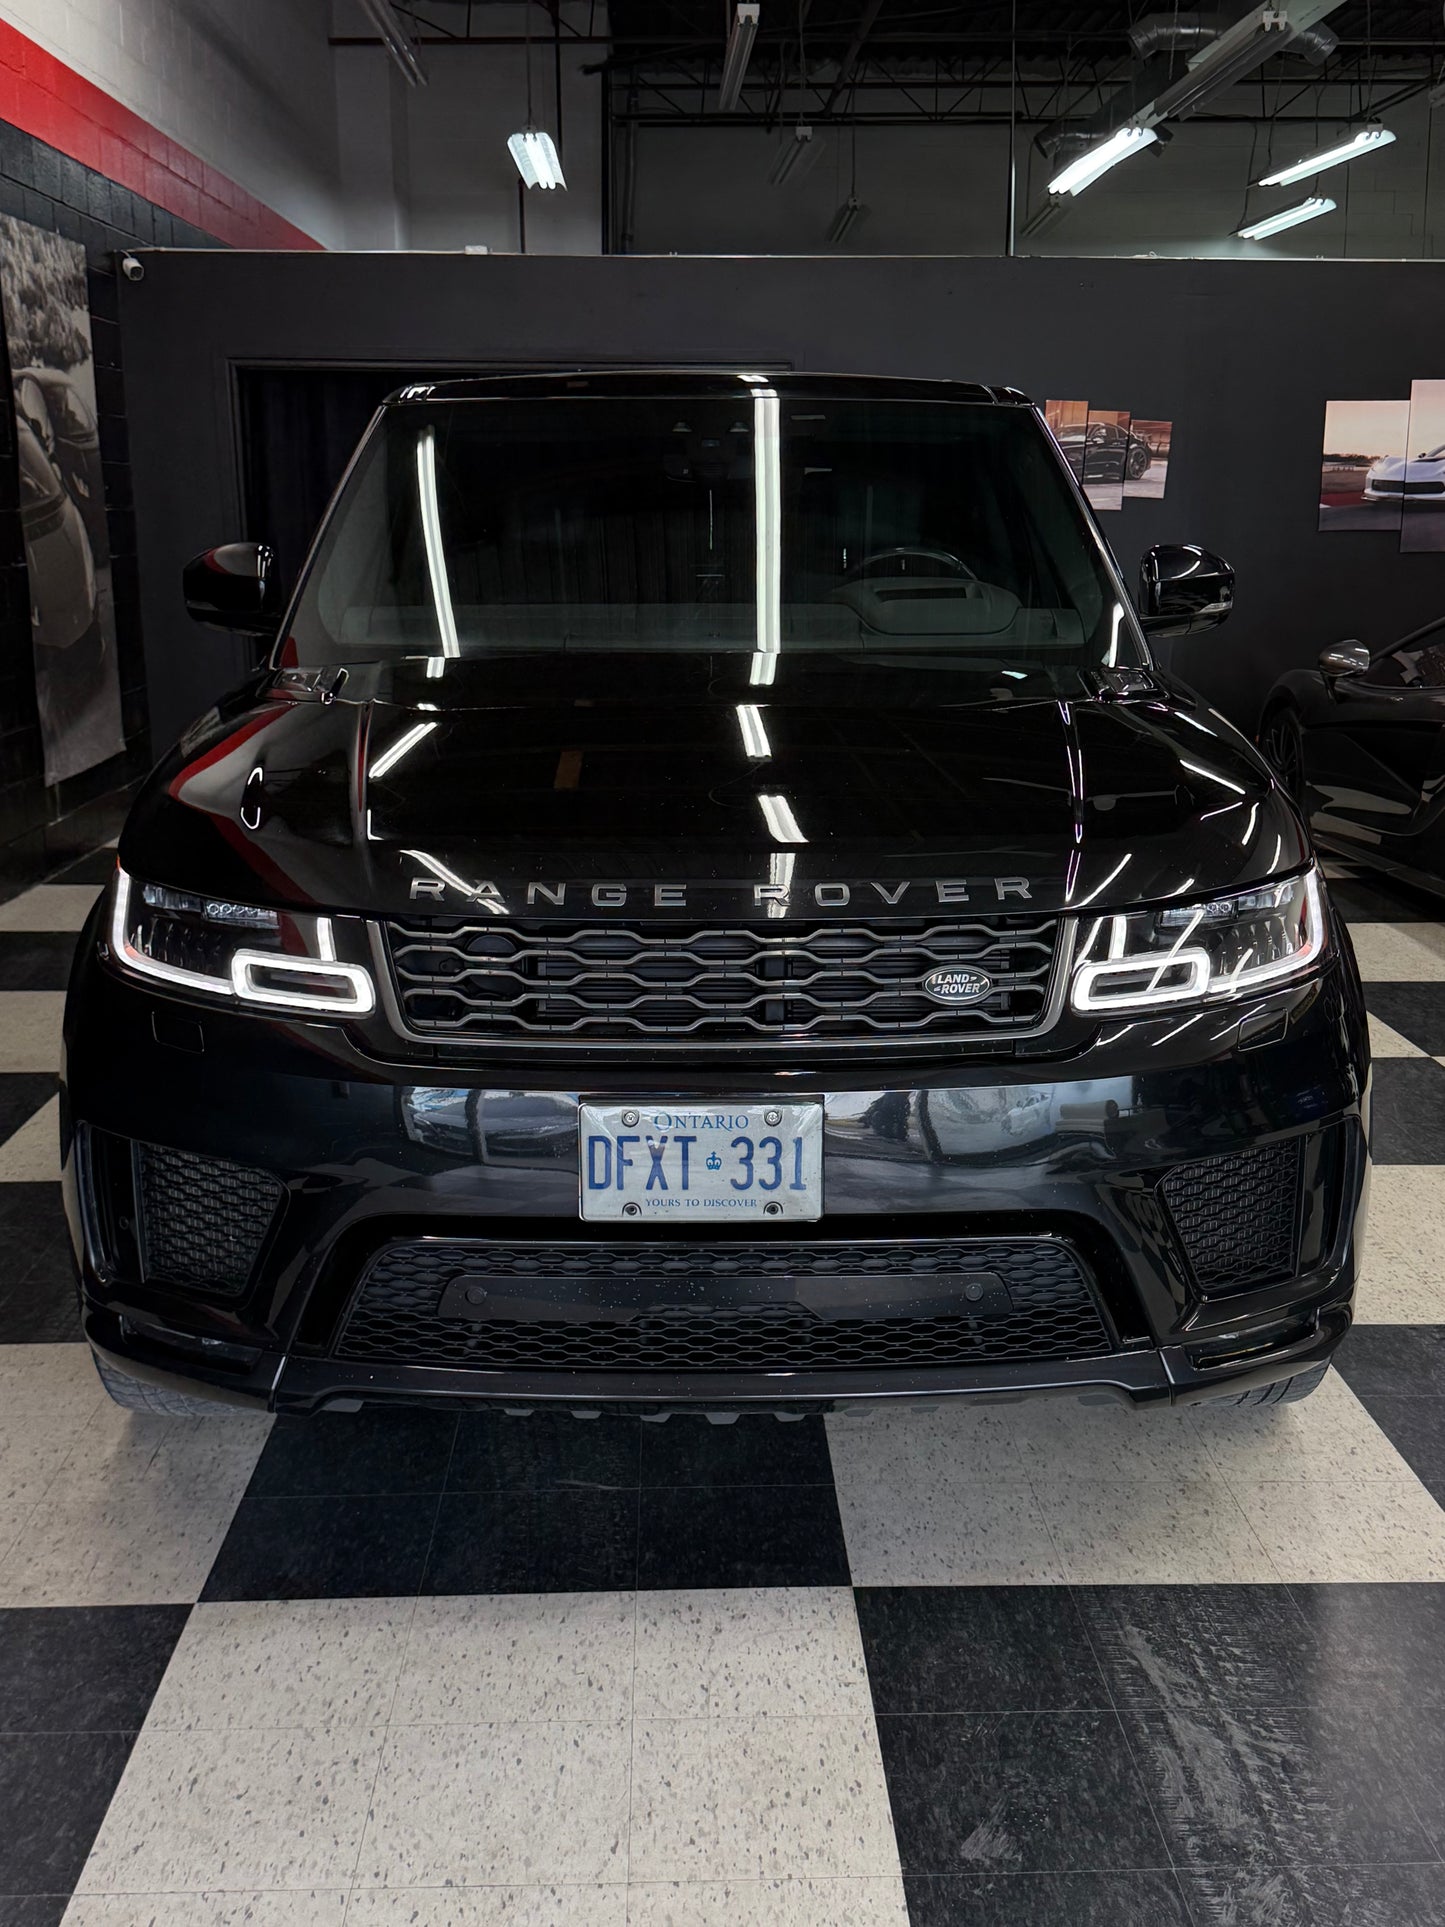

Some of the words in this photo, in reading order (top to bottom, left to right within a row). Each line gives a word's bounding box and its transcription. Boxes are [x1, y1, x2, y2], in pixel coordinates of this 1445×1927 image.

[409, 876, 687, 907] RANGE
[753, 876, 1033, 907] ROVER
[937, 973, 970, 984] LAND
[940, 983, 981, 994] ROVER
[653, 1114, 749, 1132] ONTARIO
[588, 1135, 697, 1191] DFXT
[730, 1135, 807, 1191] 331
[645, 1198, 681, 1208] YOURS
[685, 1198, 700, 1207] TO
[703, 1198, 757, 1208] DISCOVER
